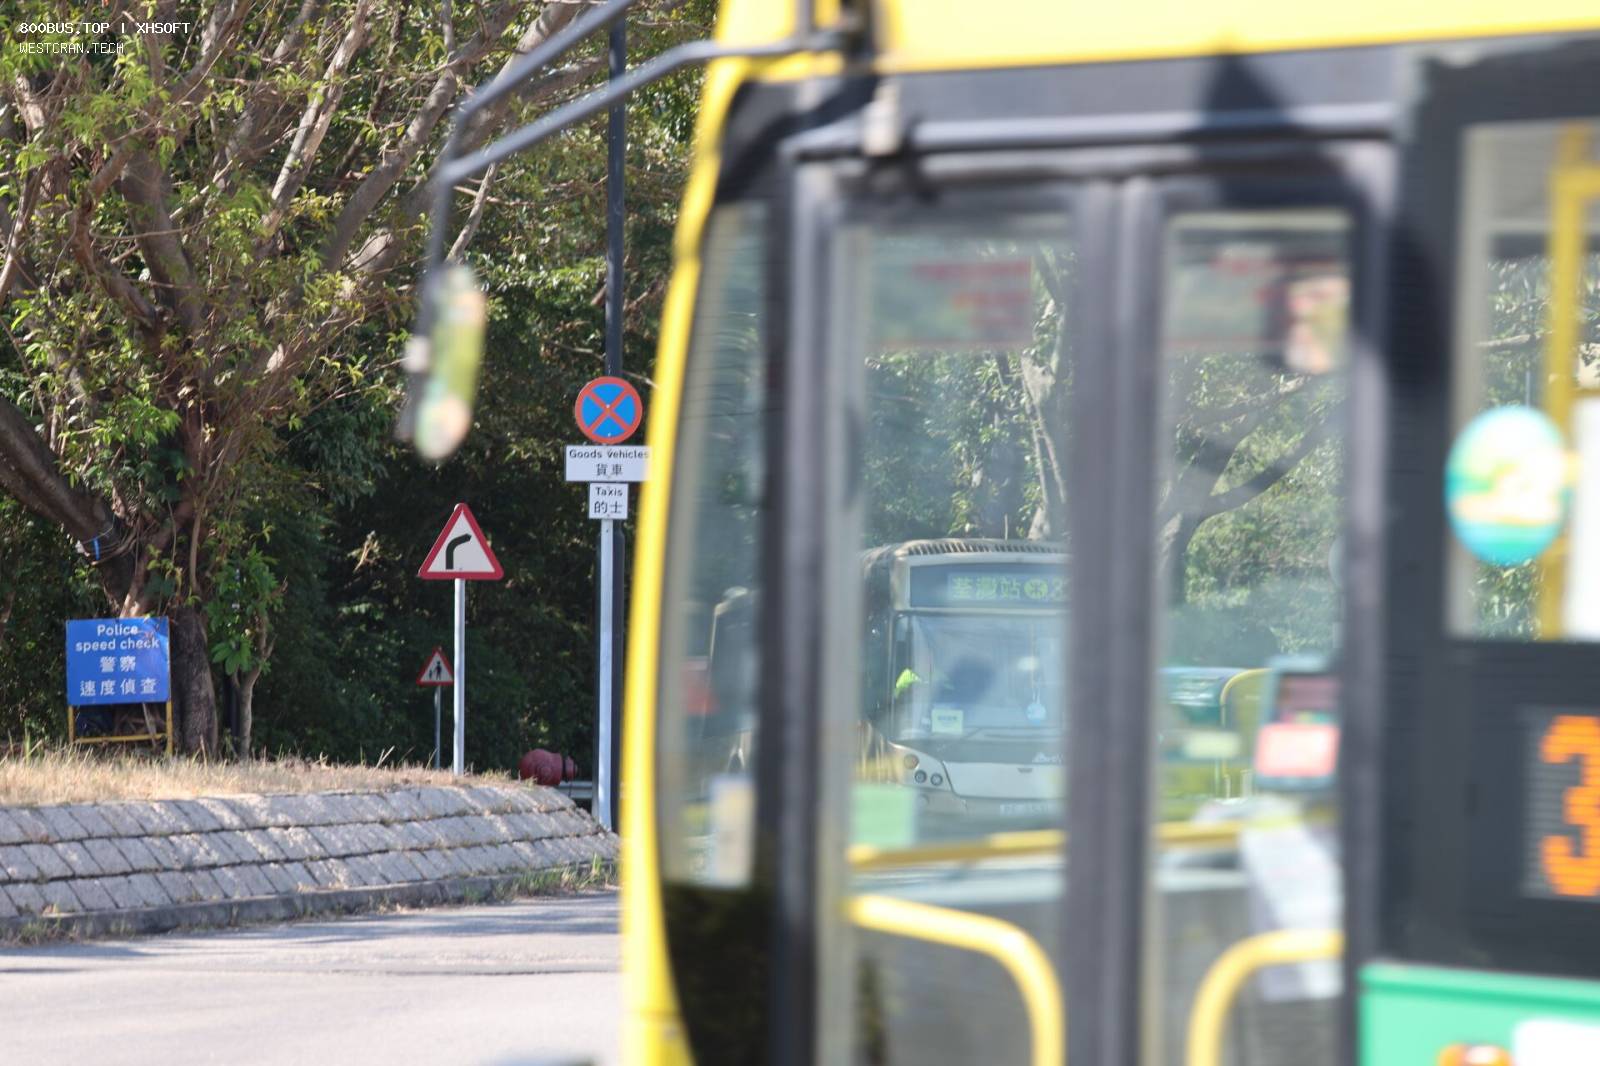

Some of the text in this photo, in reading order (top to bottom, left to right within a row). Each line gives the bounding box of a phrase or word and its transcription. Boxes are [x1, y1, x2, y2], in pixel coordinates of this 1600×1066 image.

[569, 449, 602, 459] Goods
[596, 463, 623, 476] 貨車
[595, 486, 623, 497] Taxis
[593, 501, 623, 514] 的士
[96, 624, 139, 637] Police
[75, 637, 160, 654] speed check
[99, 655, 136, 673] 警察
[79, 677, 158, 697] 速度偵查
